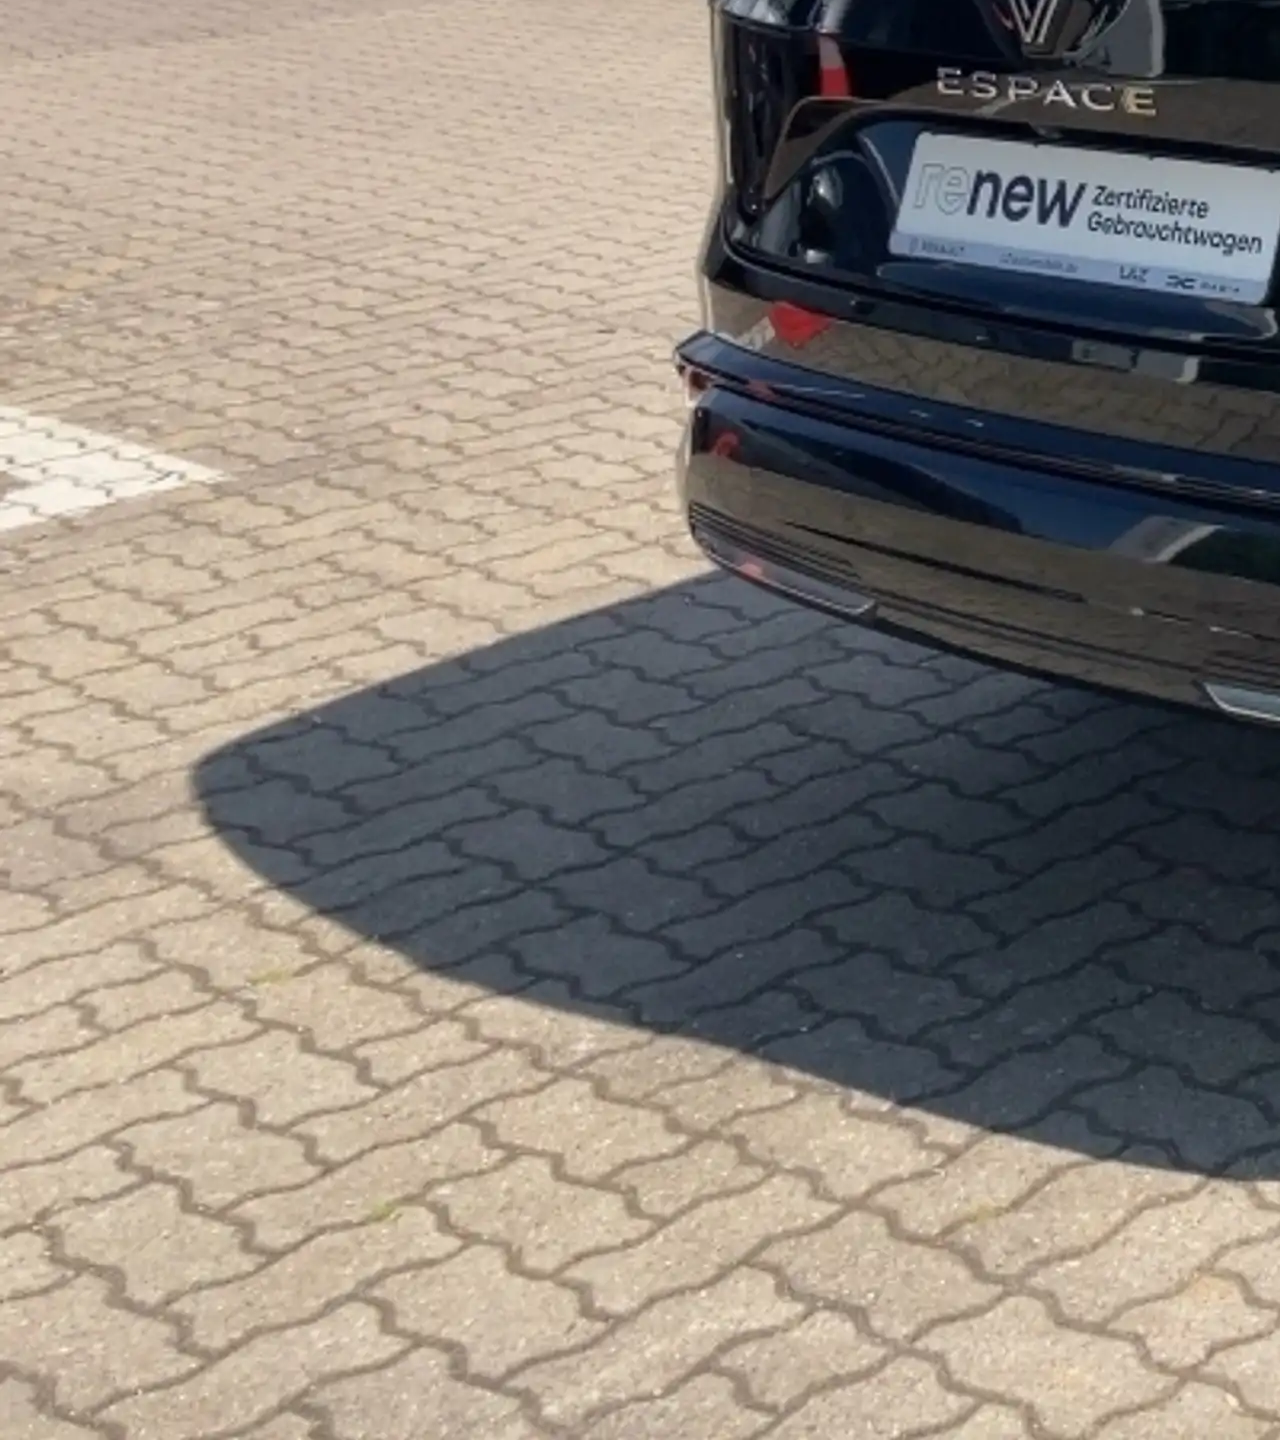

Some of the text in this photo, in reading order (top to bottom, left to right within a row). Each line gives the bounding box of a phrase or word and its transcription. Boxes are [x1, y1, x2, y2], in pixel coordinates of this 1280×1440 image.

[936, 66, 1157, 116] ESPACE
[913, 163, 1088, 229] renew
[1092, 185, 1210, 219] Zertifizierte
[1087, 211, 1263, 256] Gebrauchtwagen
